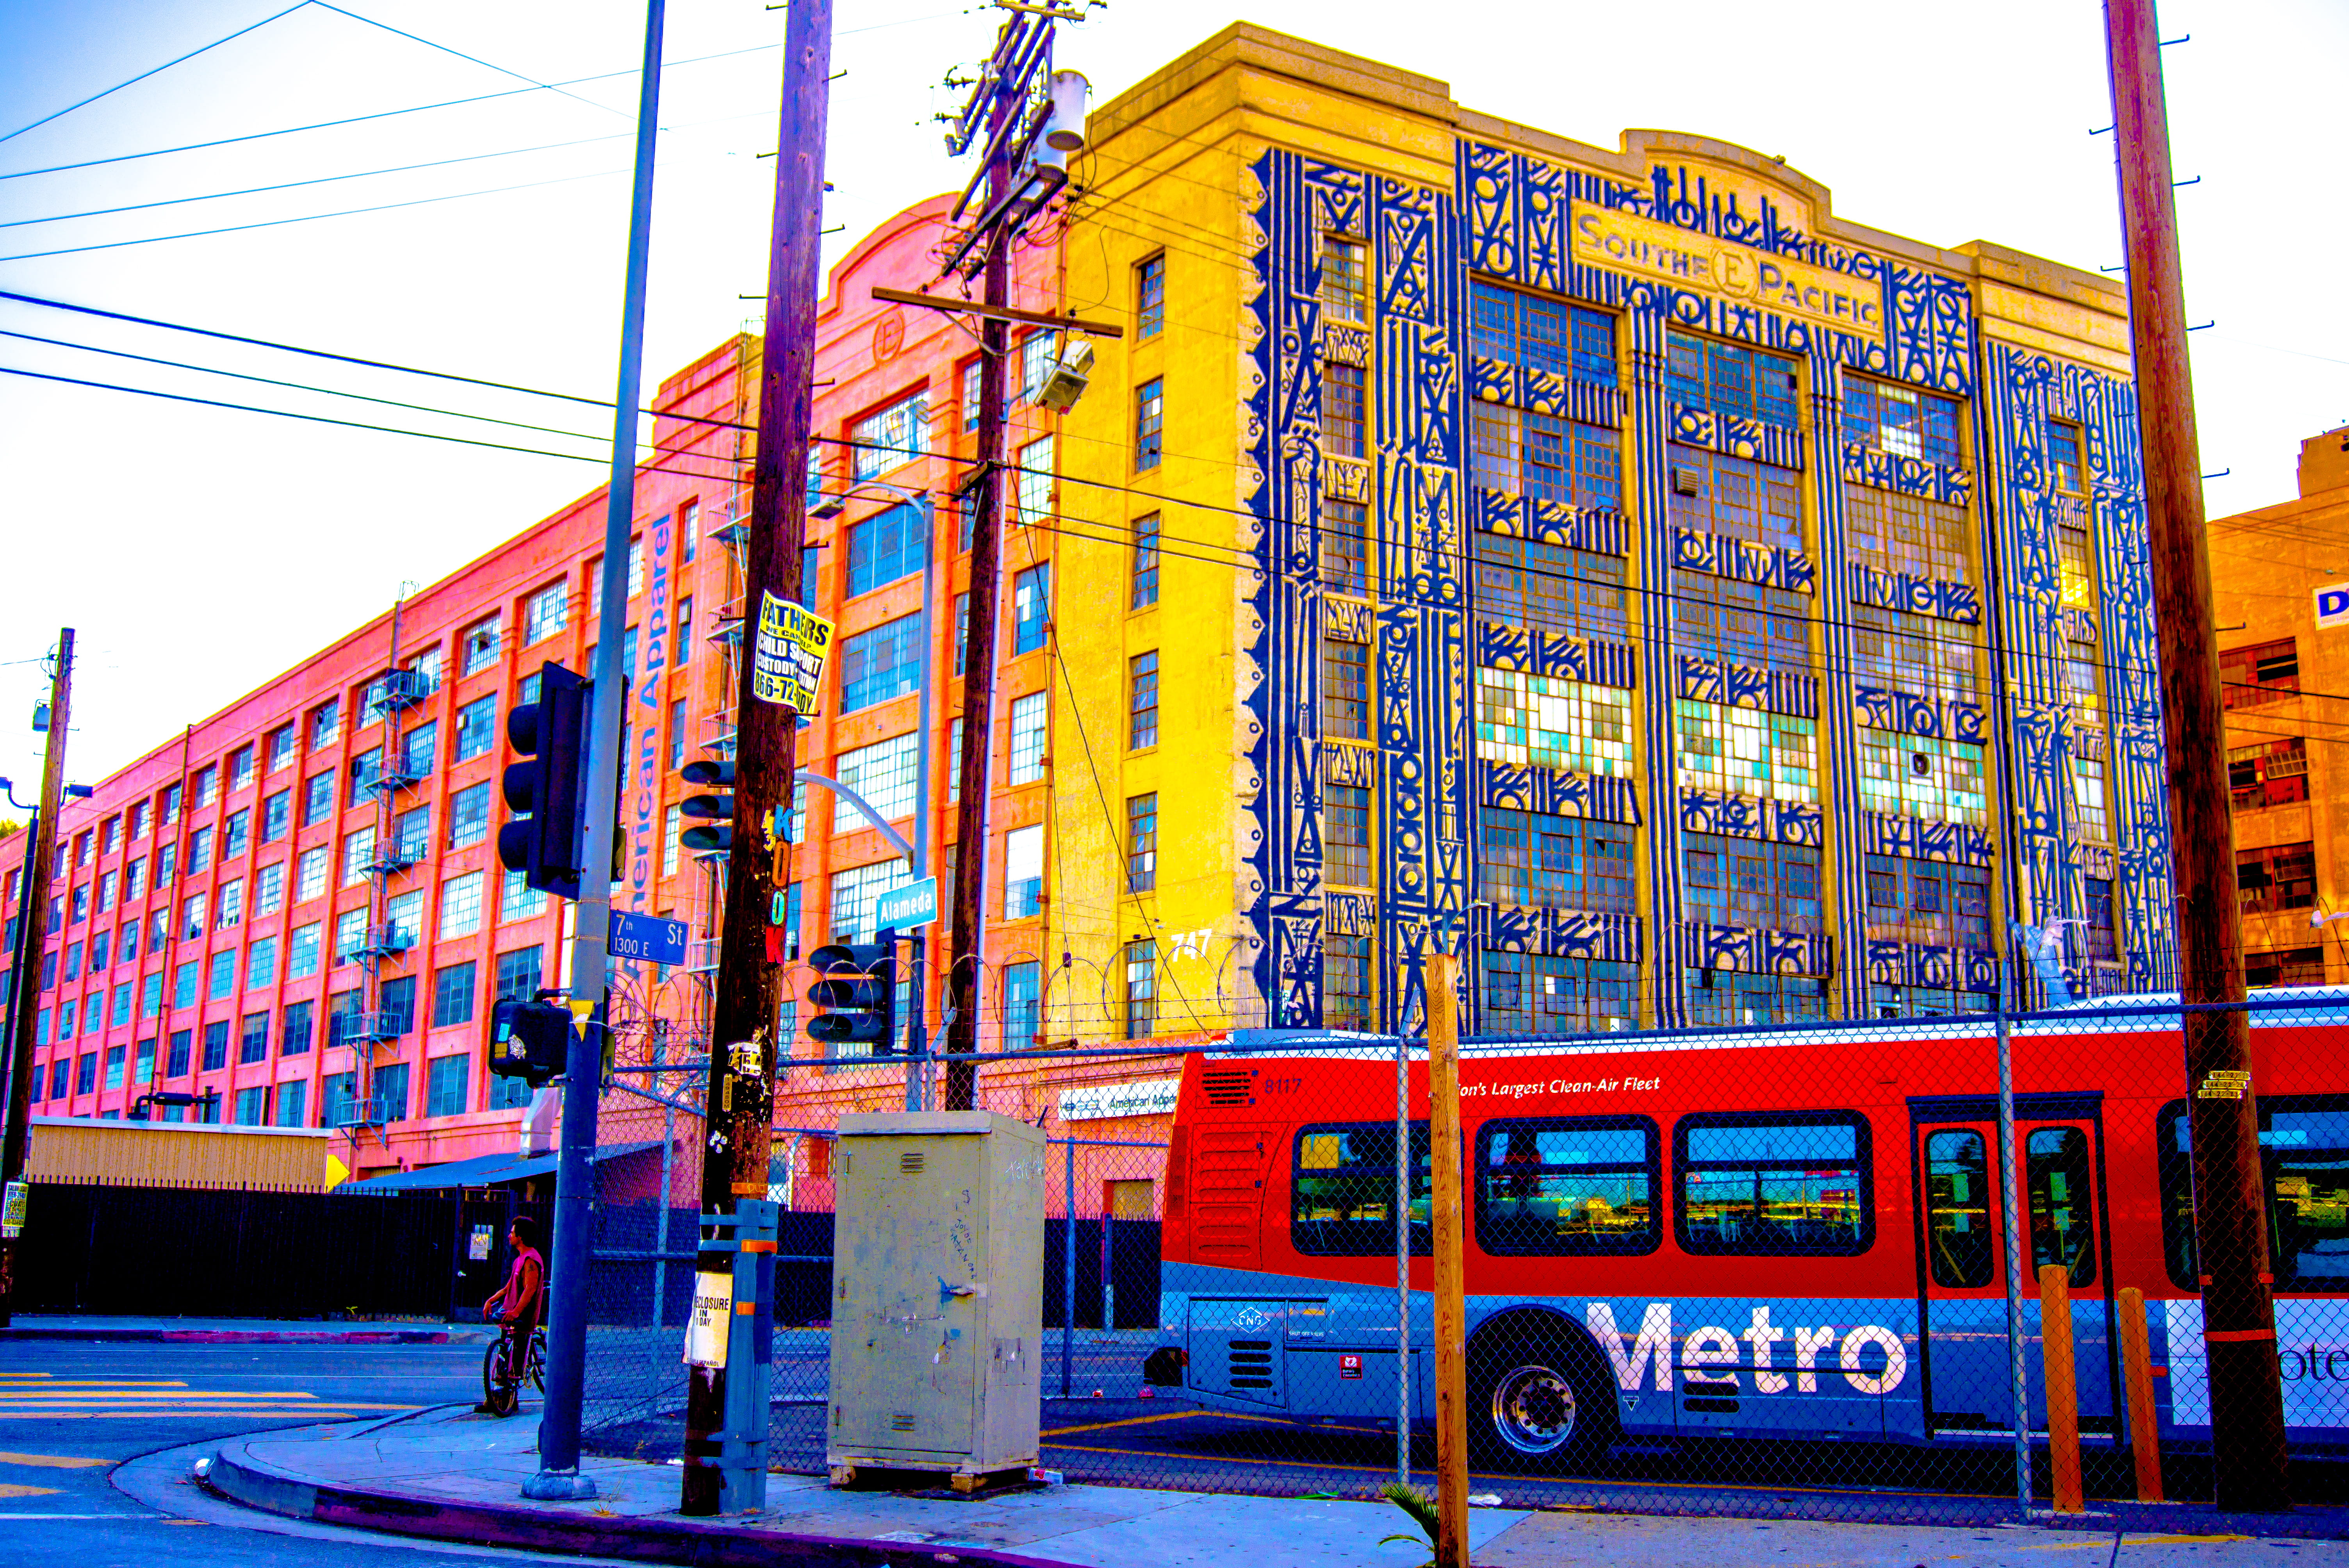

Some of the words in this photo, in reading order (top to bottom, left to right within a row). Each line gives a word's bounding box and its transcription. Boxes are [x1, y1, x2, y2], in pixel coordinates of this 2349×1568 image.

[1758, 260, 1878, 330] PACIFIC
[639, 513, 671, 709] Apparel
[763, 597, 829, 646] FATHERS
[766, 625, 778, 635] WE
[759, 633, 788, 657] CHILD
[790, 643, 821, 675] SUPORT
[880, 892, 932, 924] Alameda
[616, 914, 633, 931] 7th
[667, 923, 683, 946] St
[1171, 928, 1212, 962] 747
[615, 937, 638, 955] 1300
[643, 942, 649, 957] E
[1265, 1078, 1301, 1094] 8117
[1492, 1082, 1545, 1099] Largest
[1550, 1078, 1619, 1093] Clean-Air
[1623, 1077, 1660, 1090] Fleet
[1110, 1097, 1149, 1109] American
[700, 1318, 711, 1327] DAY
[1239, 1315, 1261, 1325] CNG
[1587, 1303, 1907, 1394] Metro
